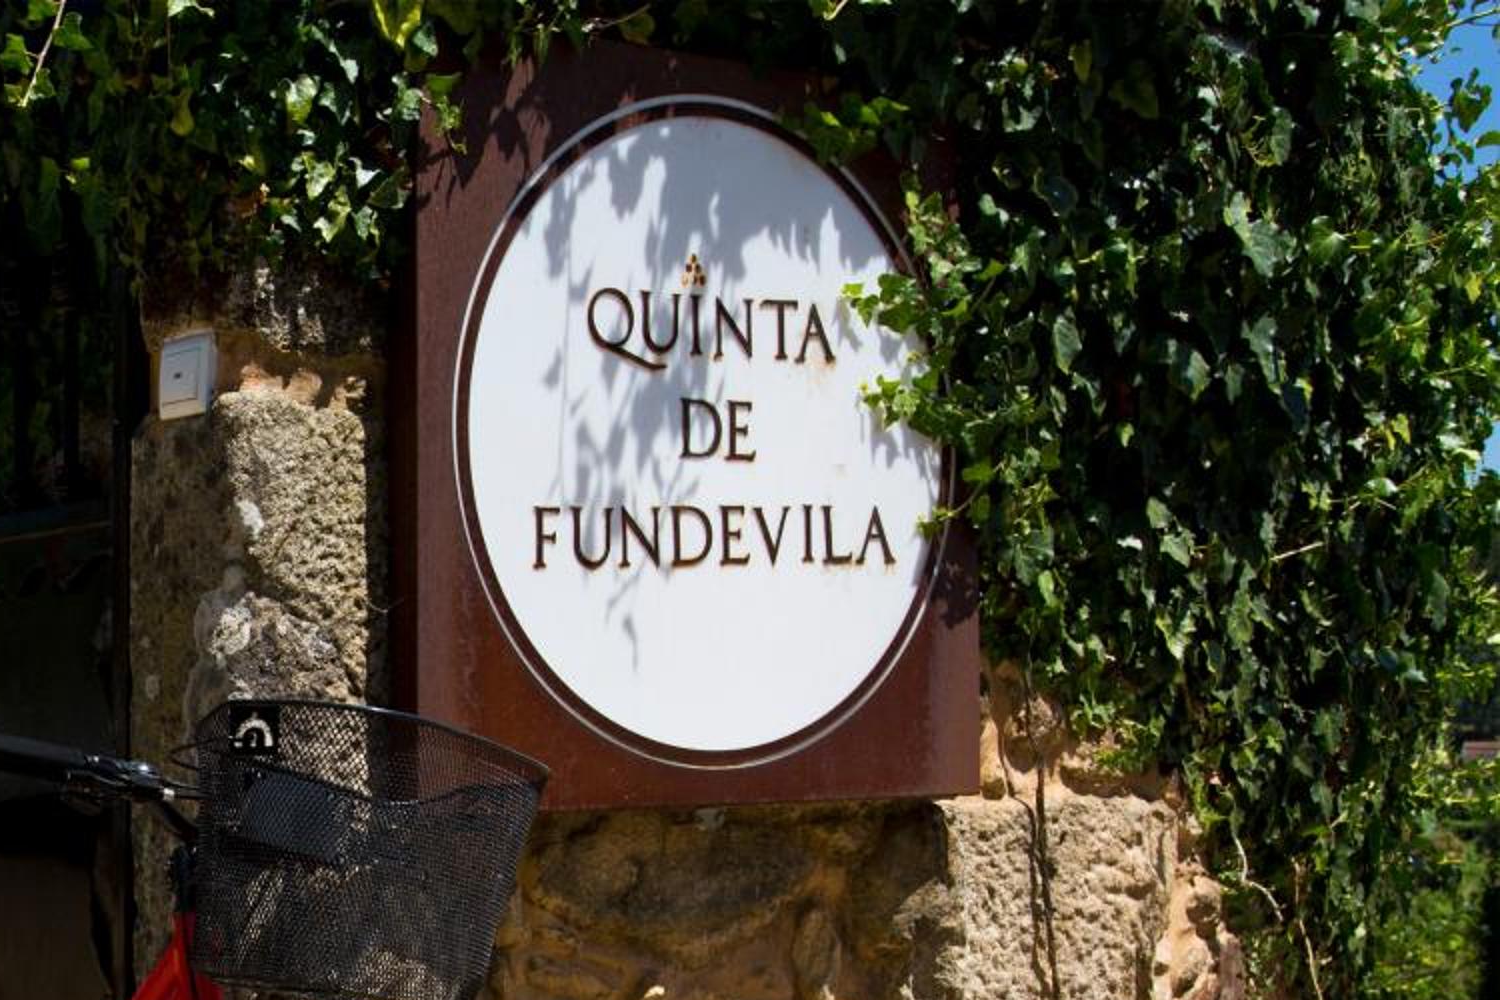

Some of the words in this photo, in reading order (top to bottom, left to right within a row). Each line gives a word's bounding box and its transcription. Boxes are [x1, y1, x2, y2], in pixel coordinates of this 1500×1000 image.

[587, 287, 836, 371] QUINTA
[679, 397, 756, 462] DE
[532, 505, 896, 570] FUNDEVILA
